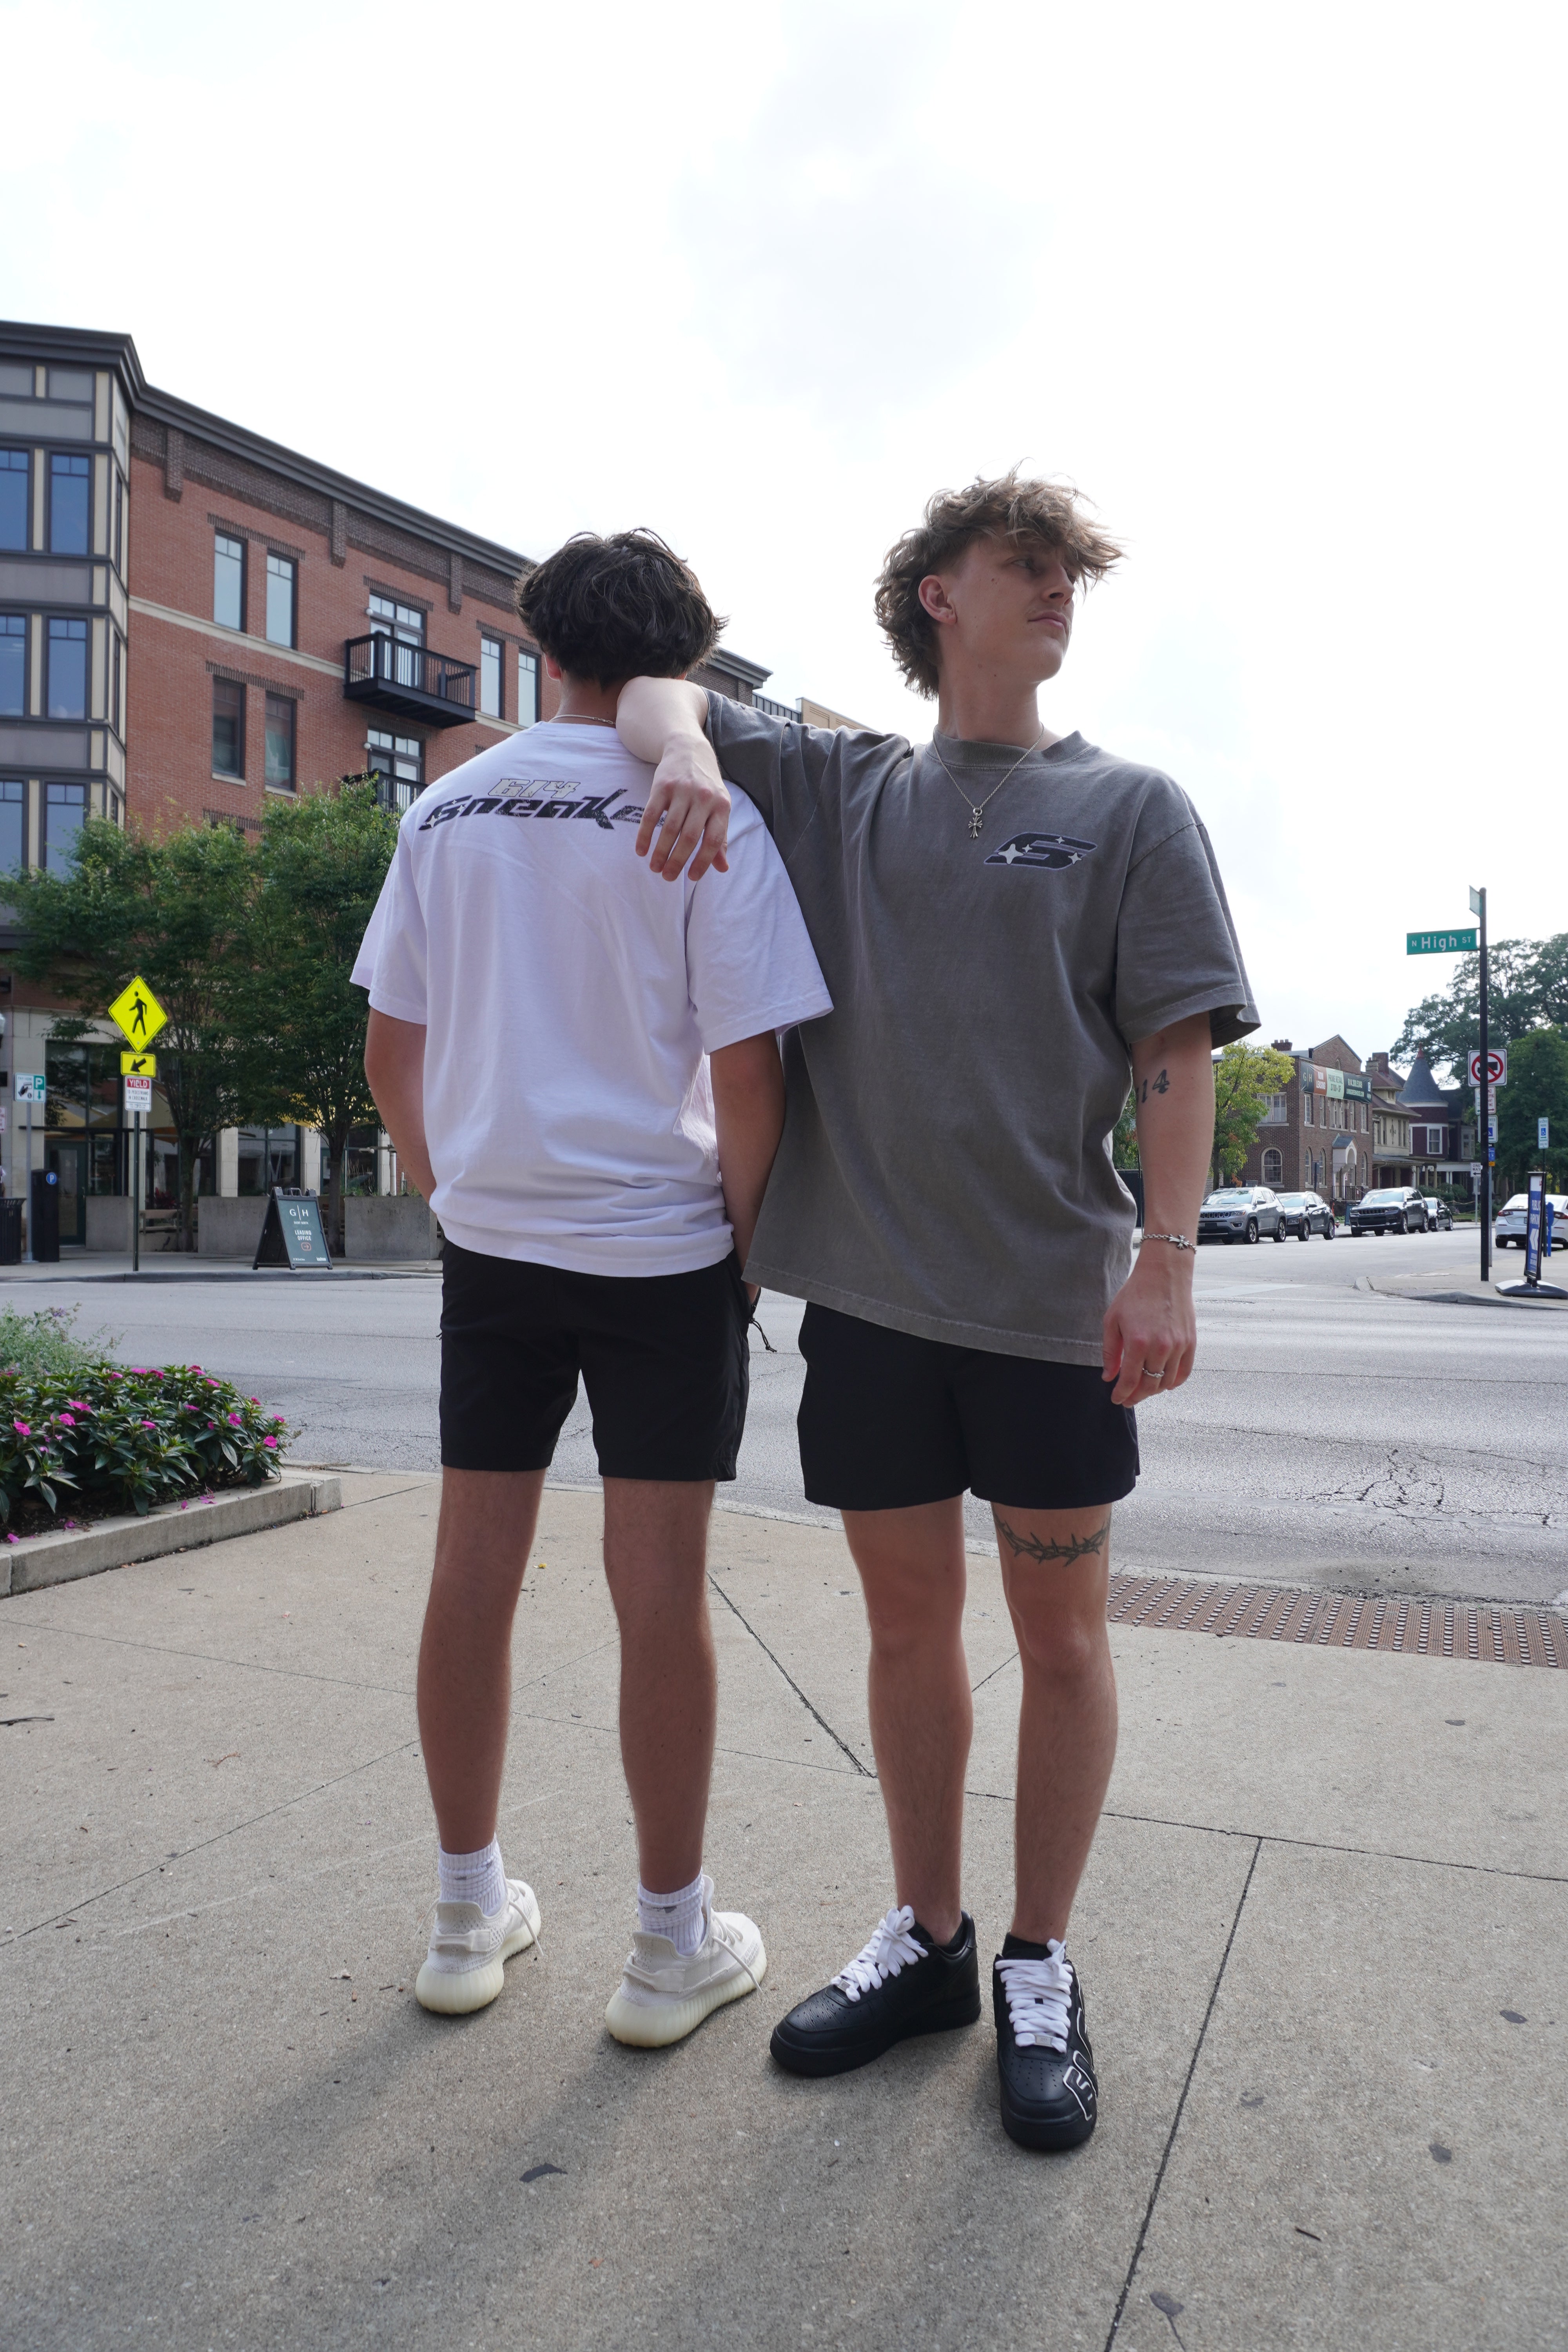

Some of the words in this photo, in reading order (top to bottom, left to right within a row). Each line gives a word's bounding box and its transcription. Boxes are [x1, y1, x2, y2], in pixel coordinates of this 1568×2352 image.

[488, 779, 581, 799] 614
[1422, 935, 1457, 951] High
[35, 1077, 43, 1088] P
[129, 1078, 147, 1088] YIELD
[1316, 1080, 1326, 1090] LEASING
[50, 1174, 54, 1183] P
